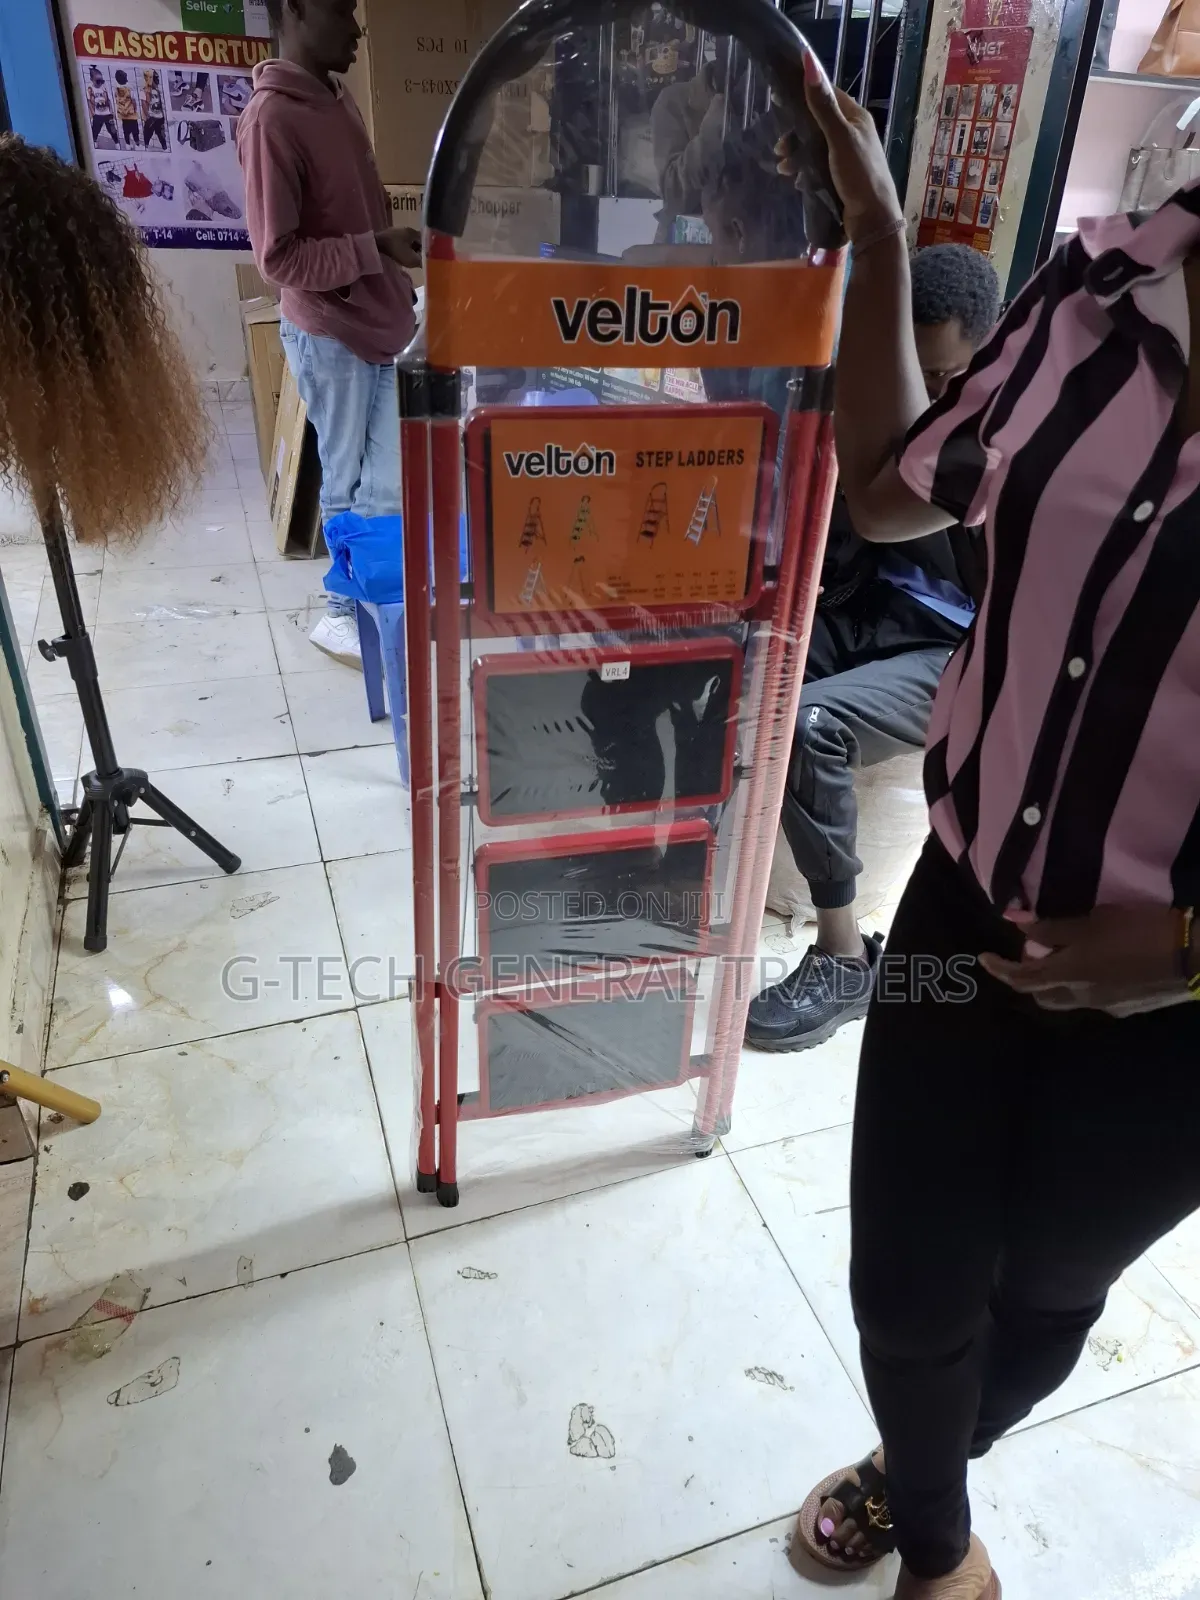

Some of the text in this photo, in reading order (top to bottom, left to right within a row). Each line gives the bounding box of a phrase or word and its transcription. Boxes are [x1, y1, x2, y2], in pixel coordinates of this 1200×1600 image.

[185, 0, 219, 15] Seller
[83, 28, 179, 60] CLASSIC
[416, 37, 468, 54] 10 PCS
[153, 229, 173, 240] T-14
[195, 230, 216, 241] Cell:
[217, 231, 239, 242] 0714
[551, 285, 741, 346] velton
[503, 442, 745, 477] velton STEP LADDERS
[605, 667, 628, 677] VRL4
